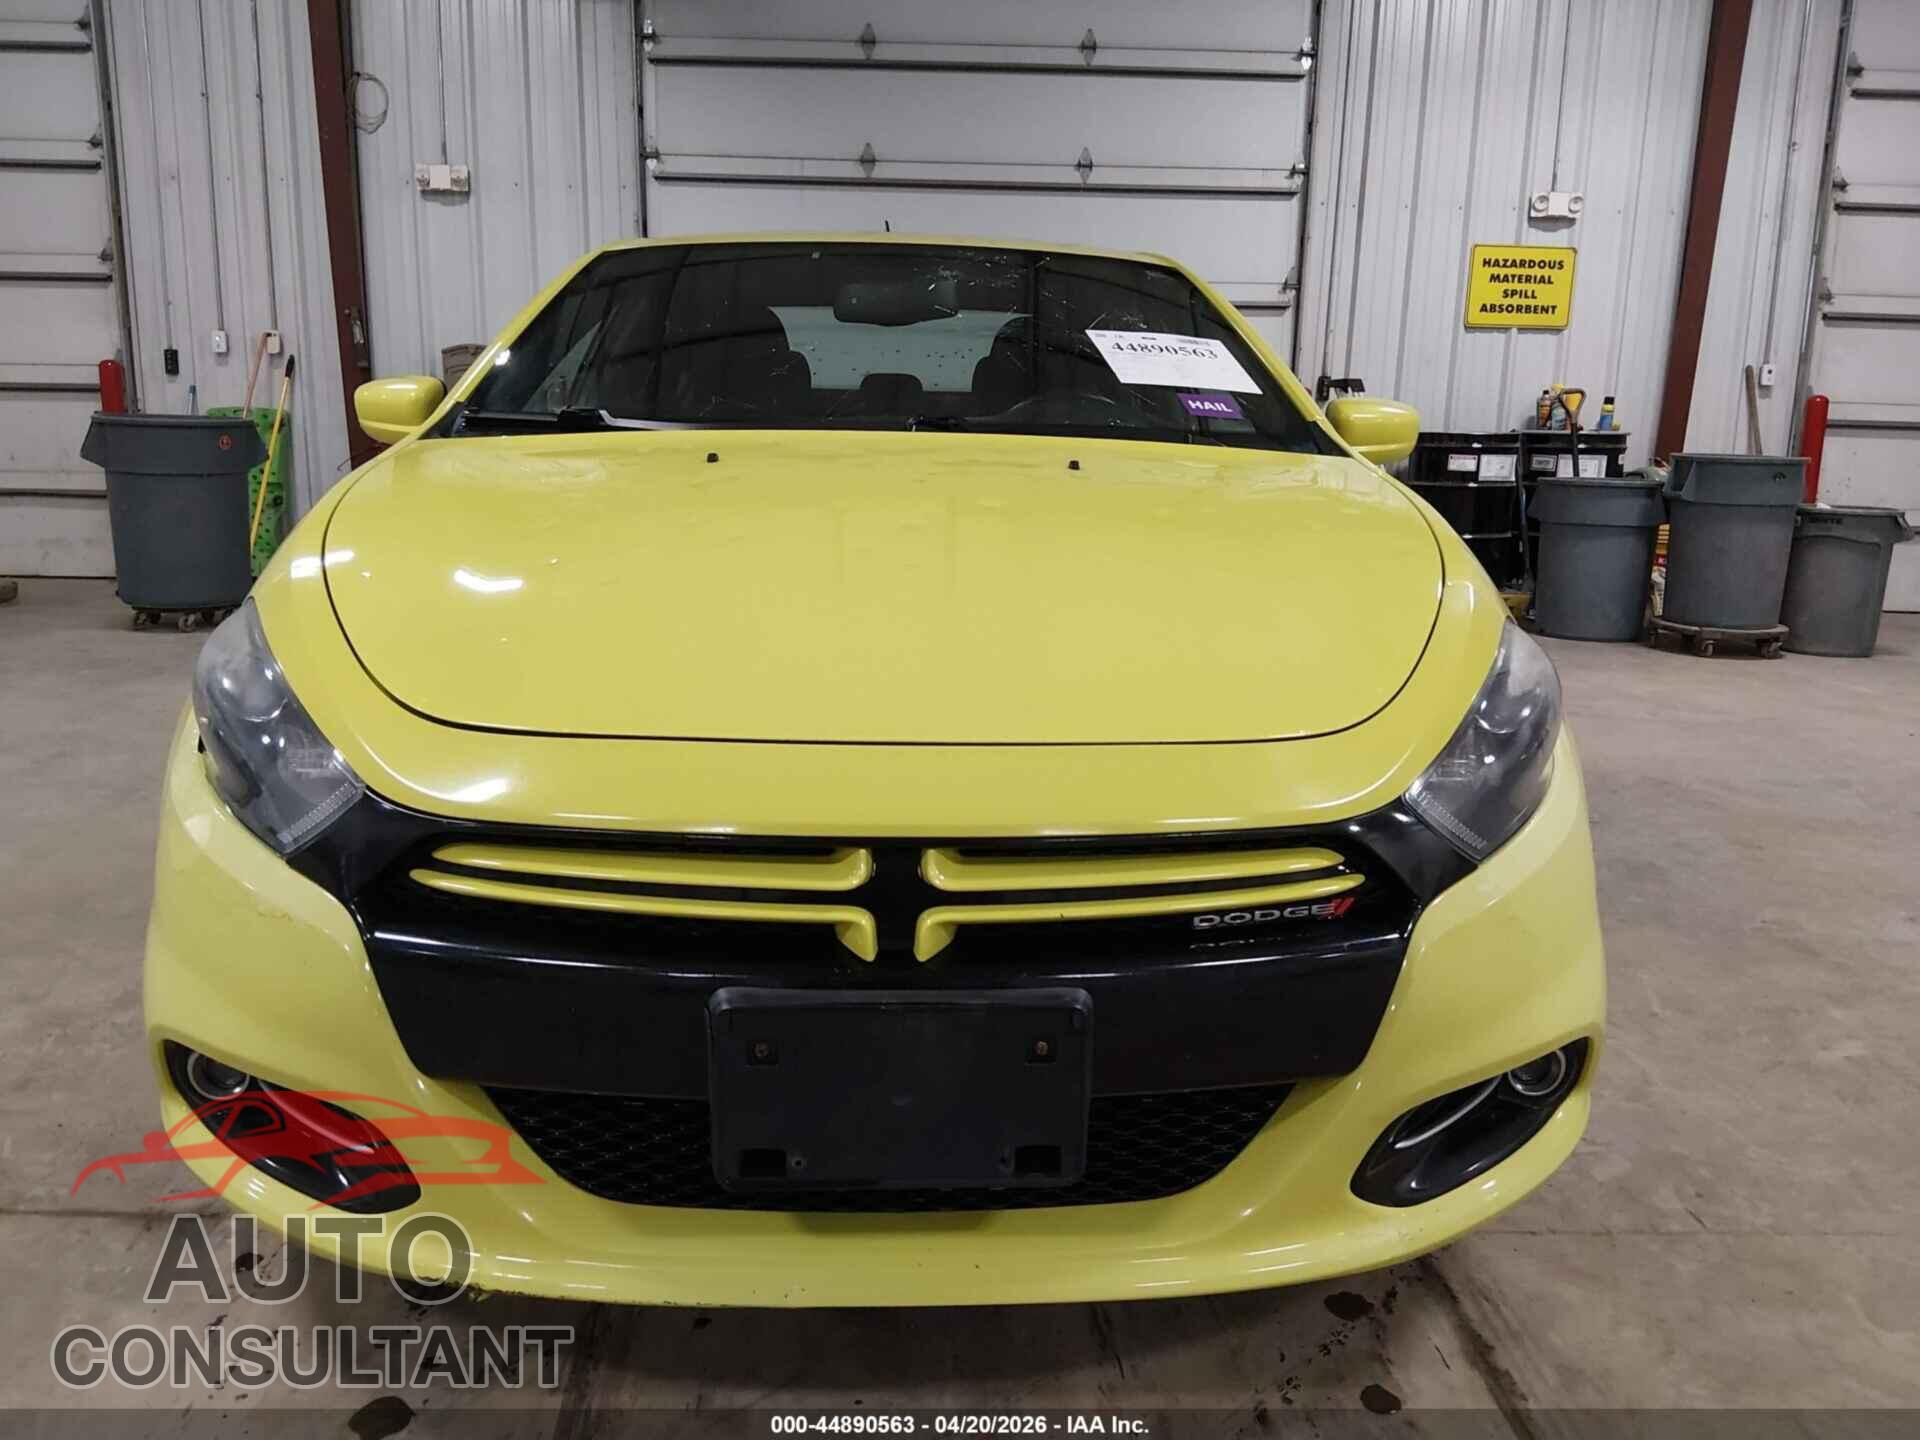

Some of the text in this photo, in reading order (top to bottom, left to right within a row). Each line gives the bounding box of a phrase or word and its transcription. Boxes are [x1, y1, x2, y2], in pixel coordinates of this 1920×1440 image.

[1482, 258, 1565, 270] HAZARDOUS
[1489, 273, 1554, 285] MATERIAL
[1502, 288, 1537, 299] SPILL
[1479, 303, 1557, 315] ABSORBENT
[1111, 341, 1218, 360] 44890563
[1187, 400, 1233, 412] HAIL
[1192, 904, 1335, 928] DODGE
